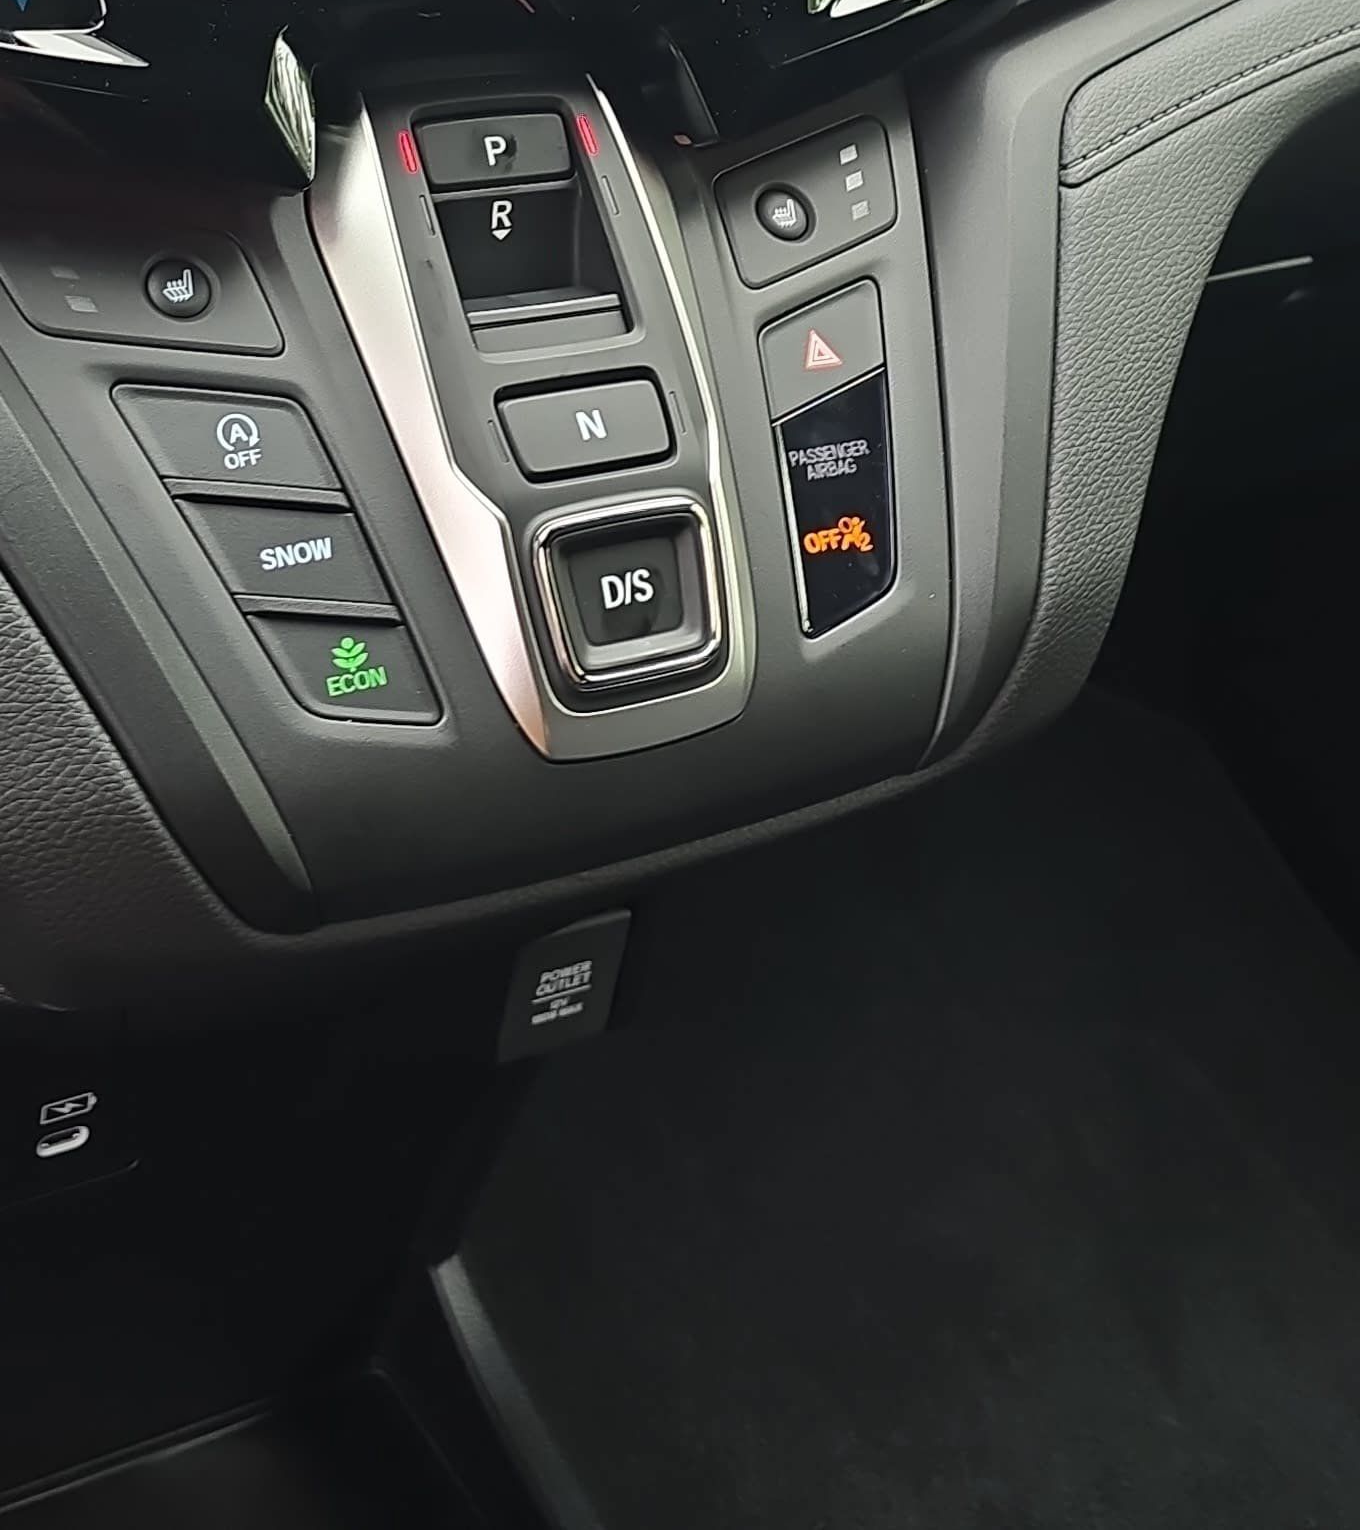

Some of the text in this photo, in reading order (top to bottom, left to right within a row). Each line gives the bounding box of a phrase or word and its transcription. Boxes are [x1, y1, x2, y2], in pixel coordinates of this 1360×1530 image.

[484, 136, 507, 167] P
[491, 200, 513, 230] R
[575, 409, 608, 442] N
[224, 448, 263, 471] OFF
[788, 438, 872, 467] PASSENGER
[806, 458, 858, 482] AIRBAG
[260, 537, 333, 571] SNOW
[803, 528, 842, 555] OFF
[601, 569, 654, 611] D/S
[325, 665, 389, 697] ECON
[536, 971, 593, 996] OUTLET
[540, 960, 593, 983] POWER
